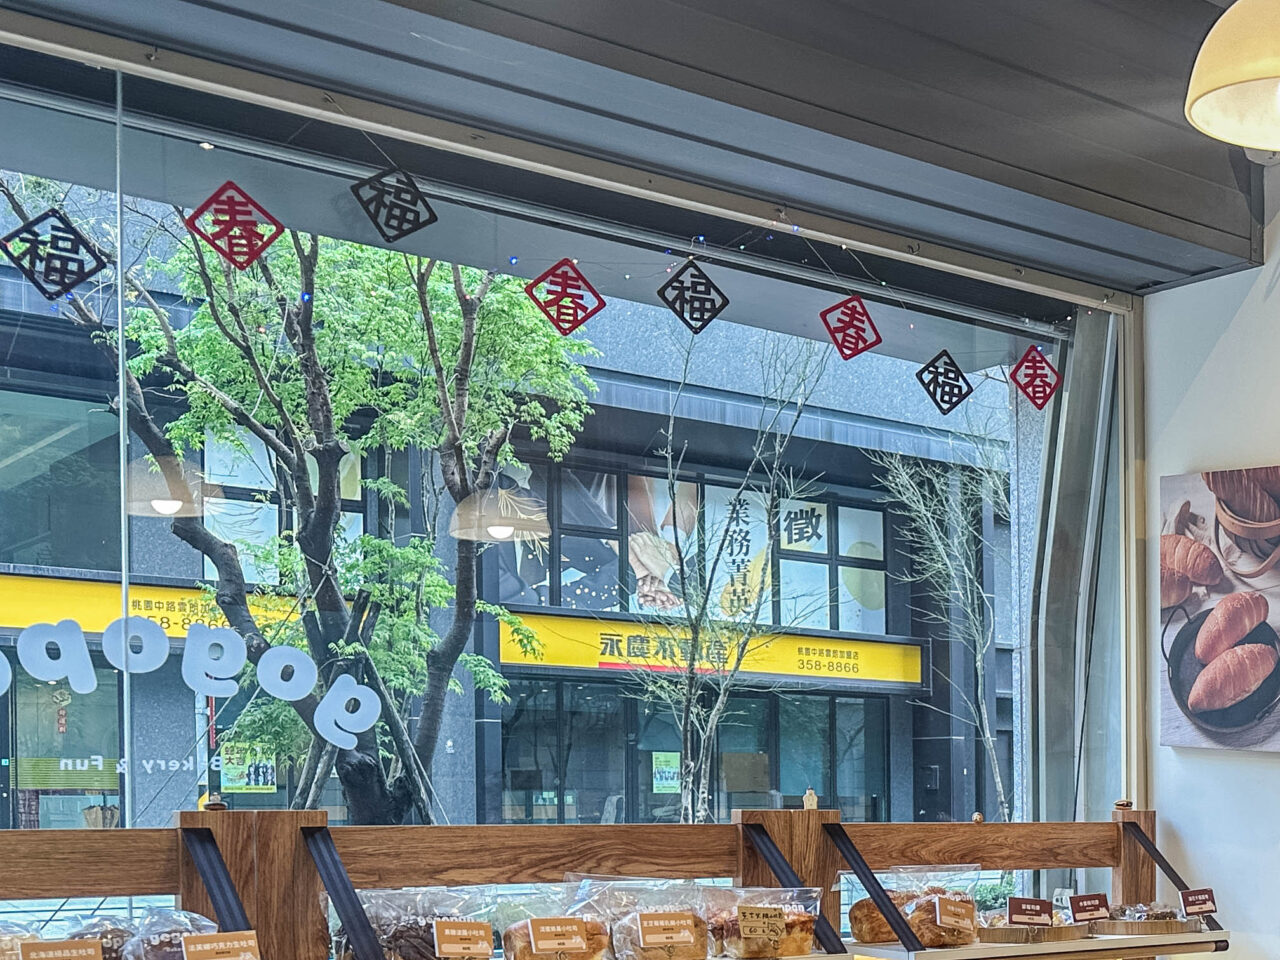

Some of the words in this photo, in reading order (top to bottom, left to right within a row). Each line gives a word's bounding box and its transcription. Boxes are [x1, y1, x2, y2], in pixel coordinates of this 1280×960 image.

[210, 194, 265, 264] 春
[366, 177, 423, 235] 福
[17, 223, 85, 288] 福
[544, 270, 589, 326] 春
[670, 272, 717, 322] 福
[832, 303, 869, 351] 春
[926, 360, 963, 404] 福
[1022, 355, 1053, 400] 春
[783, 507, 823, 545] 徵
[797, 658, 860, 674] 358-8866
